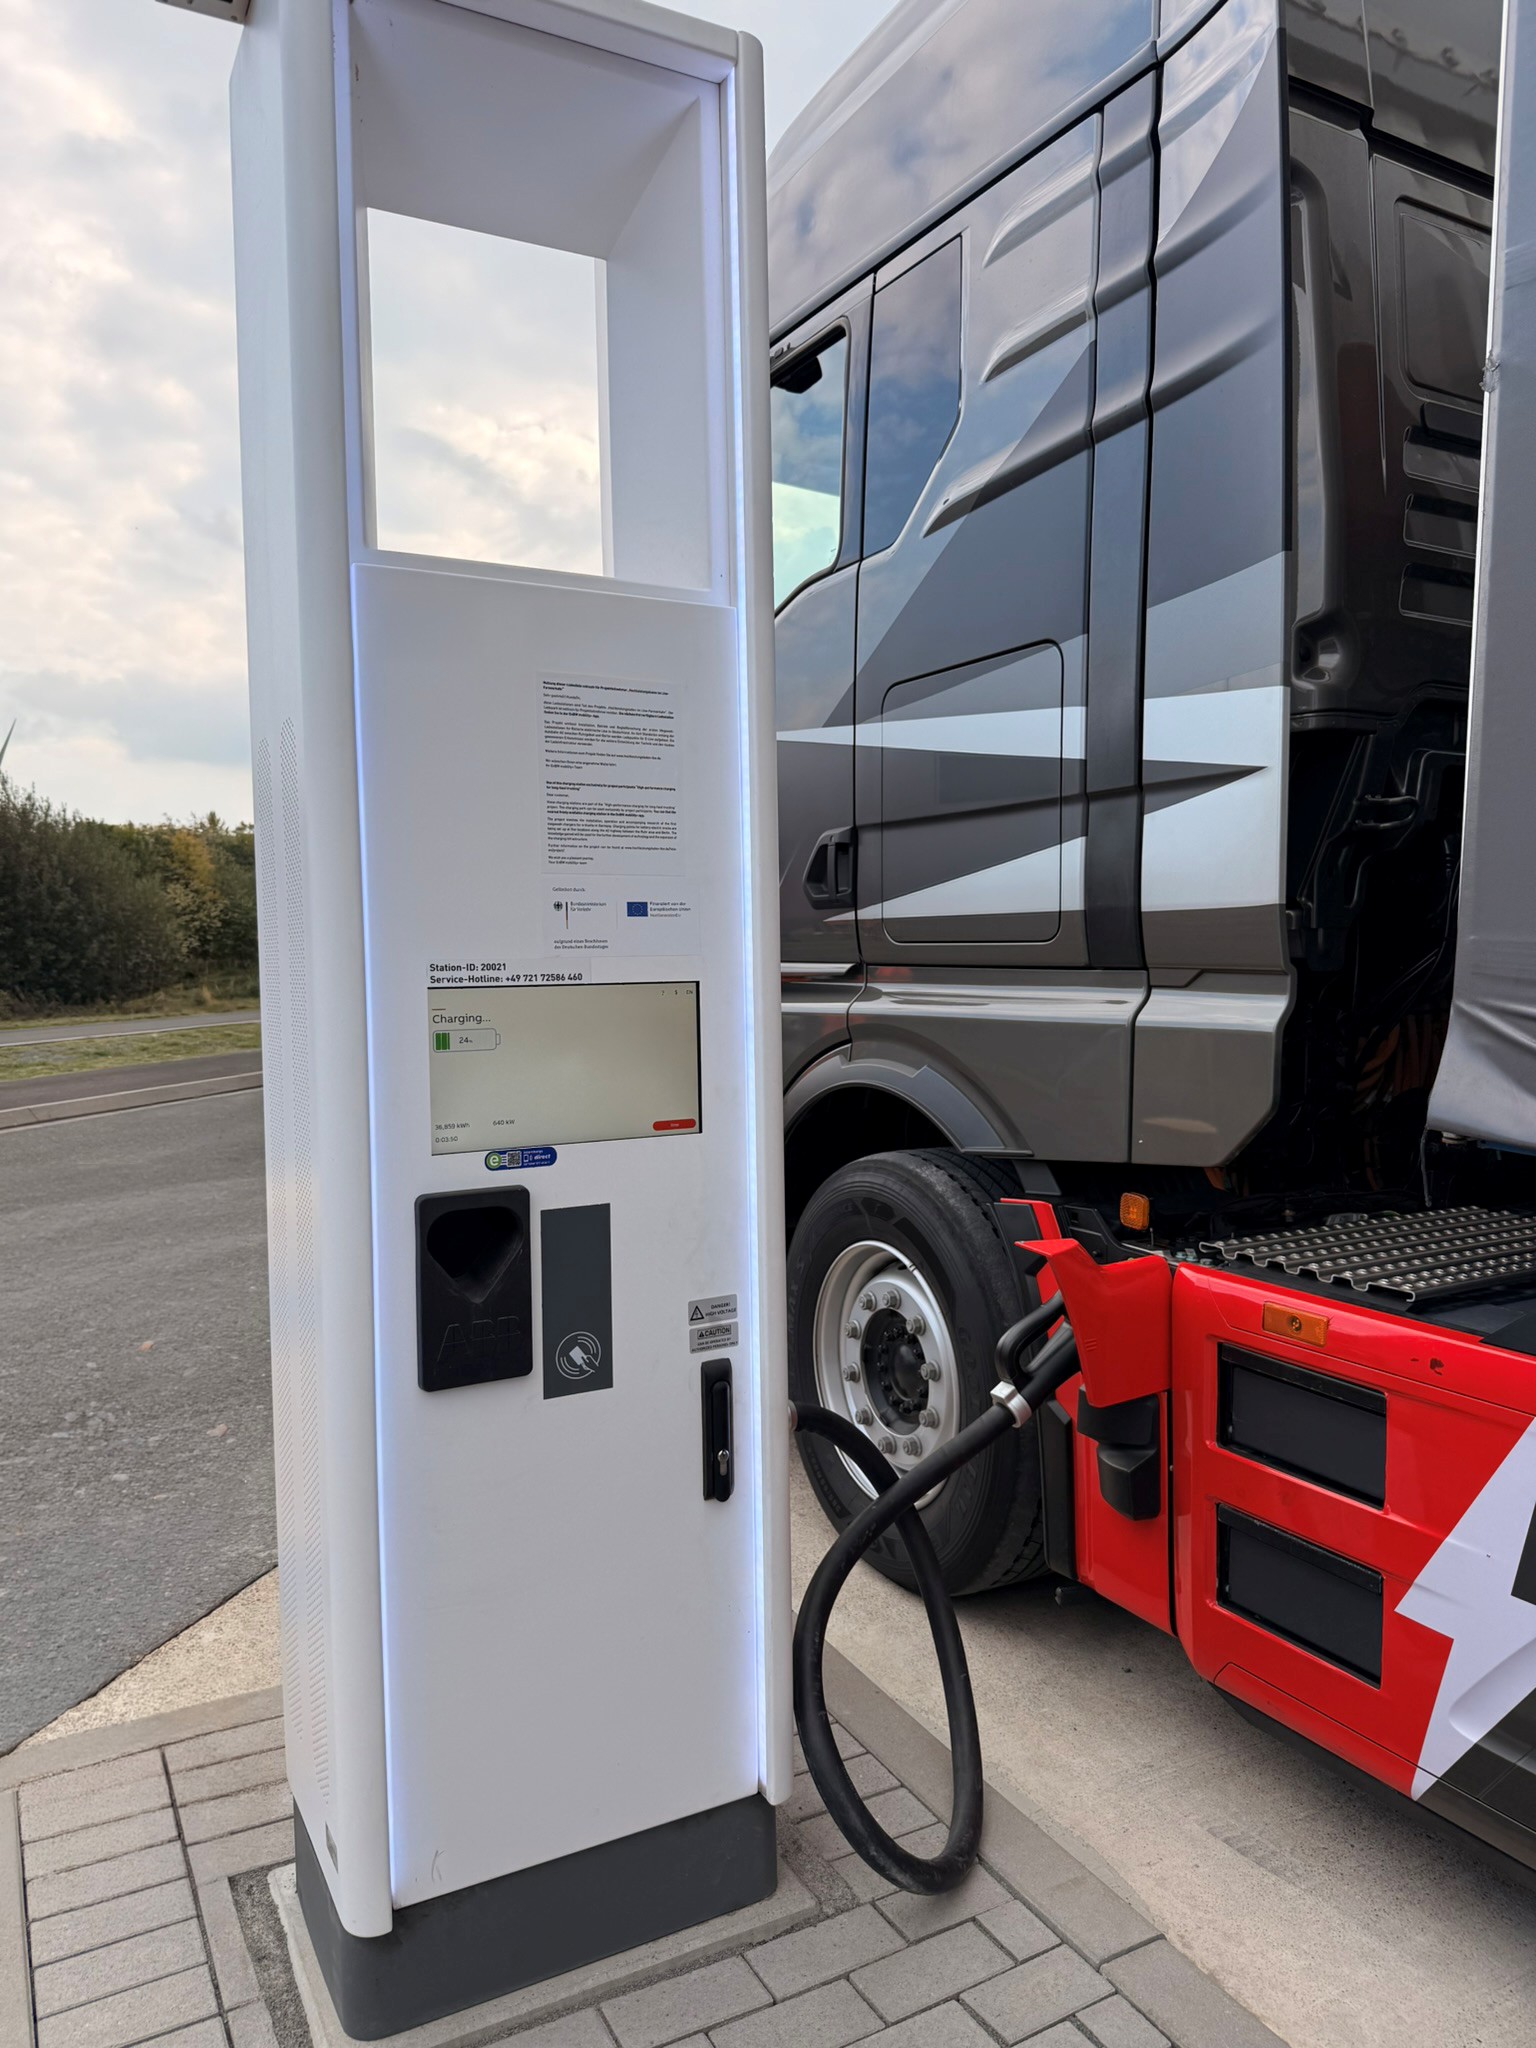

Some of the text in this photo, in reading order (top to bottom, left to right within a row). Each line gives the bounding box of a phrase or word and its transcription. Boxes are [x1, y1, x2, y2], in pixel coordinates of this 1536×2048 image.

[429, 963, 507, 972] Station-ID: 20021
[430, 973, 583, 984] Service-Hotline: +49 721 72586 460
[432, 1013, 491, 1026] Charging...
[704, 1327, 730, 1336] CAUTION
